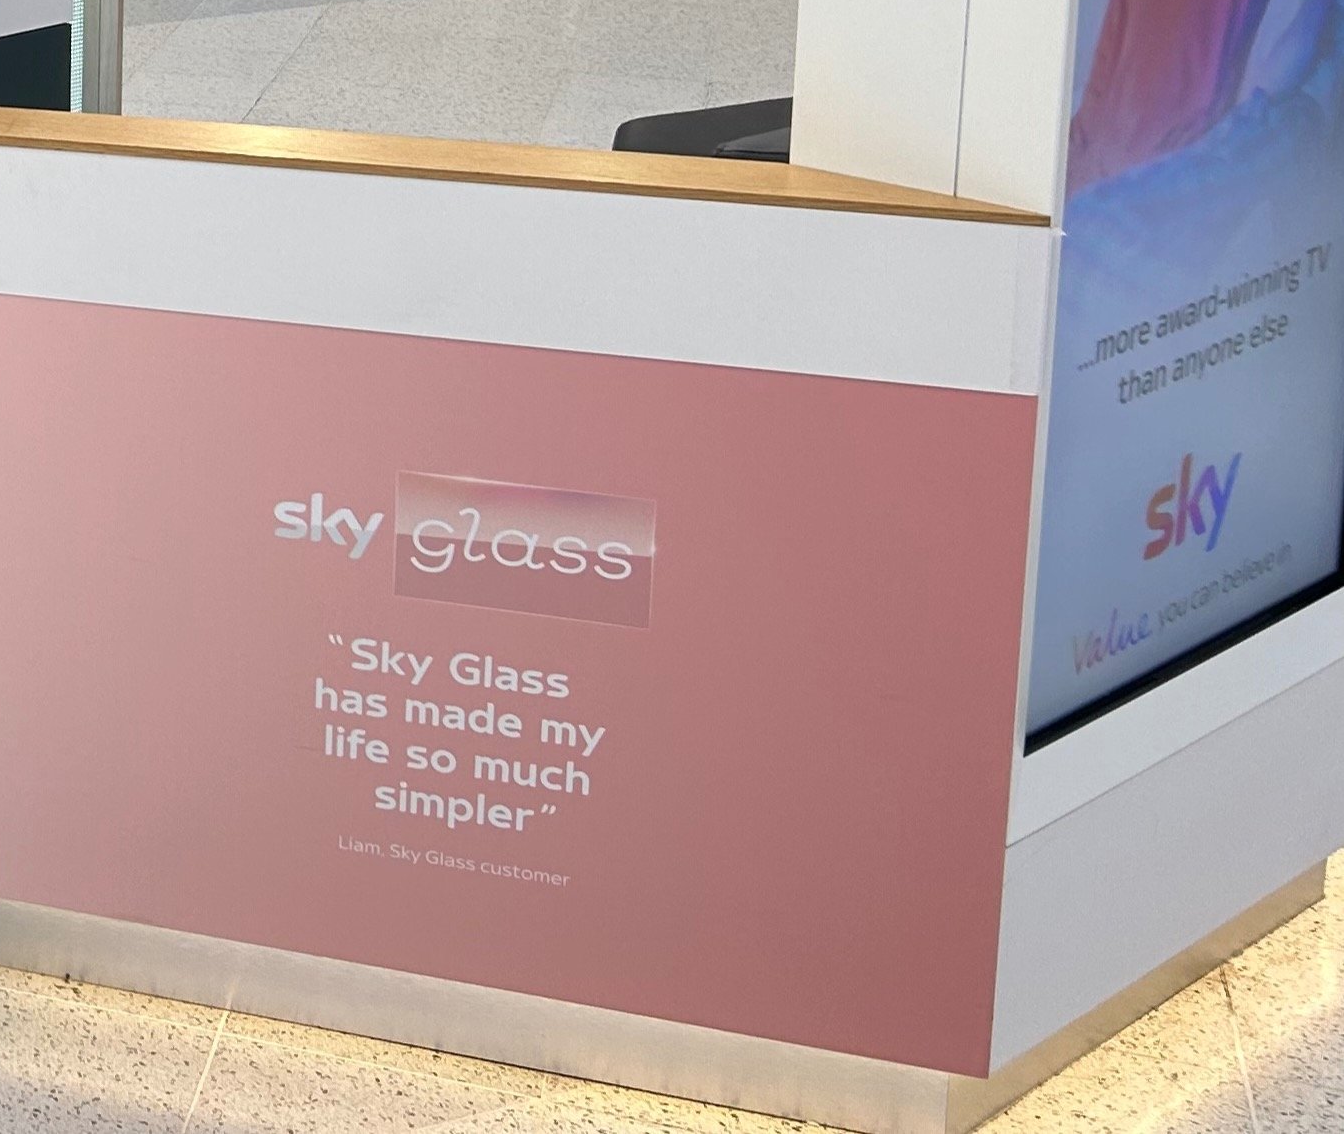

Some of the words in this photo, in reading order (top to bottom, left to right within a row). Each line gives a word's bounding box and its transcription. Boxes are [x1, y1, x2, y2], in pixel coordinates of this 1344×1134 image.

[1155, 255, 1301, 339] award-winning
[1305, 242, 1331, 275] TV
[1118, 357, 1169, 405] than
[1171, 330, 1245, 383] anyone
[1249, 313, 1290, 352] else
[274, 492, 385, 560] sky
[410, 507, 634, 580] glass
[1143, 452, 1242, 562] sky
[1071, 606, 1154, 675] Value
[1157, 592, 1188, 626] you
[1190, 578, 1219, 612] can
[315, 677, 387, 719] has
[405, 698, 522, 739] made
[540, 715, 606, 757] my
[448, 652, 571, 699] Glass
[324, 724, 389, 765] life
[406, 741, 457, 775] so
[474, 751, 591, 797] much
[389, 841, 421, 864] Sky
[425, 848, 476, 873] Glass
[479, 857, 571, 888] customer
